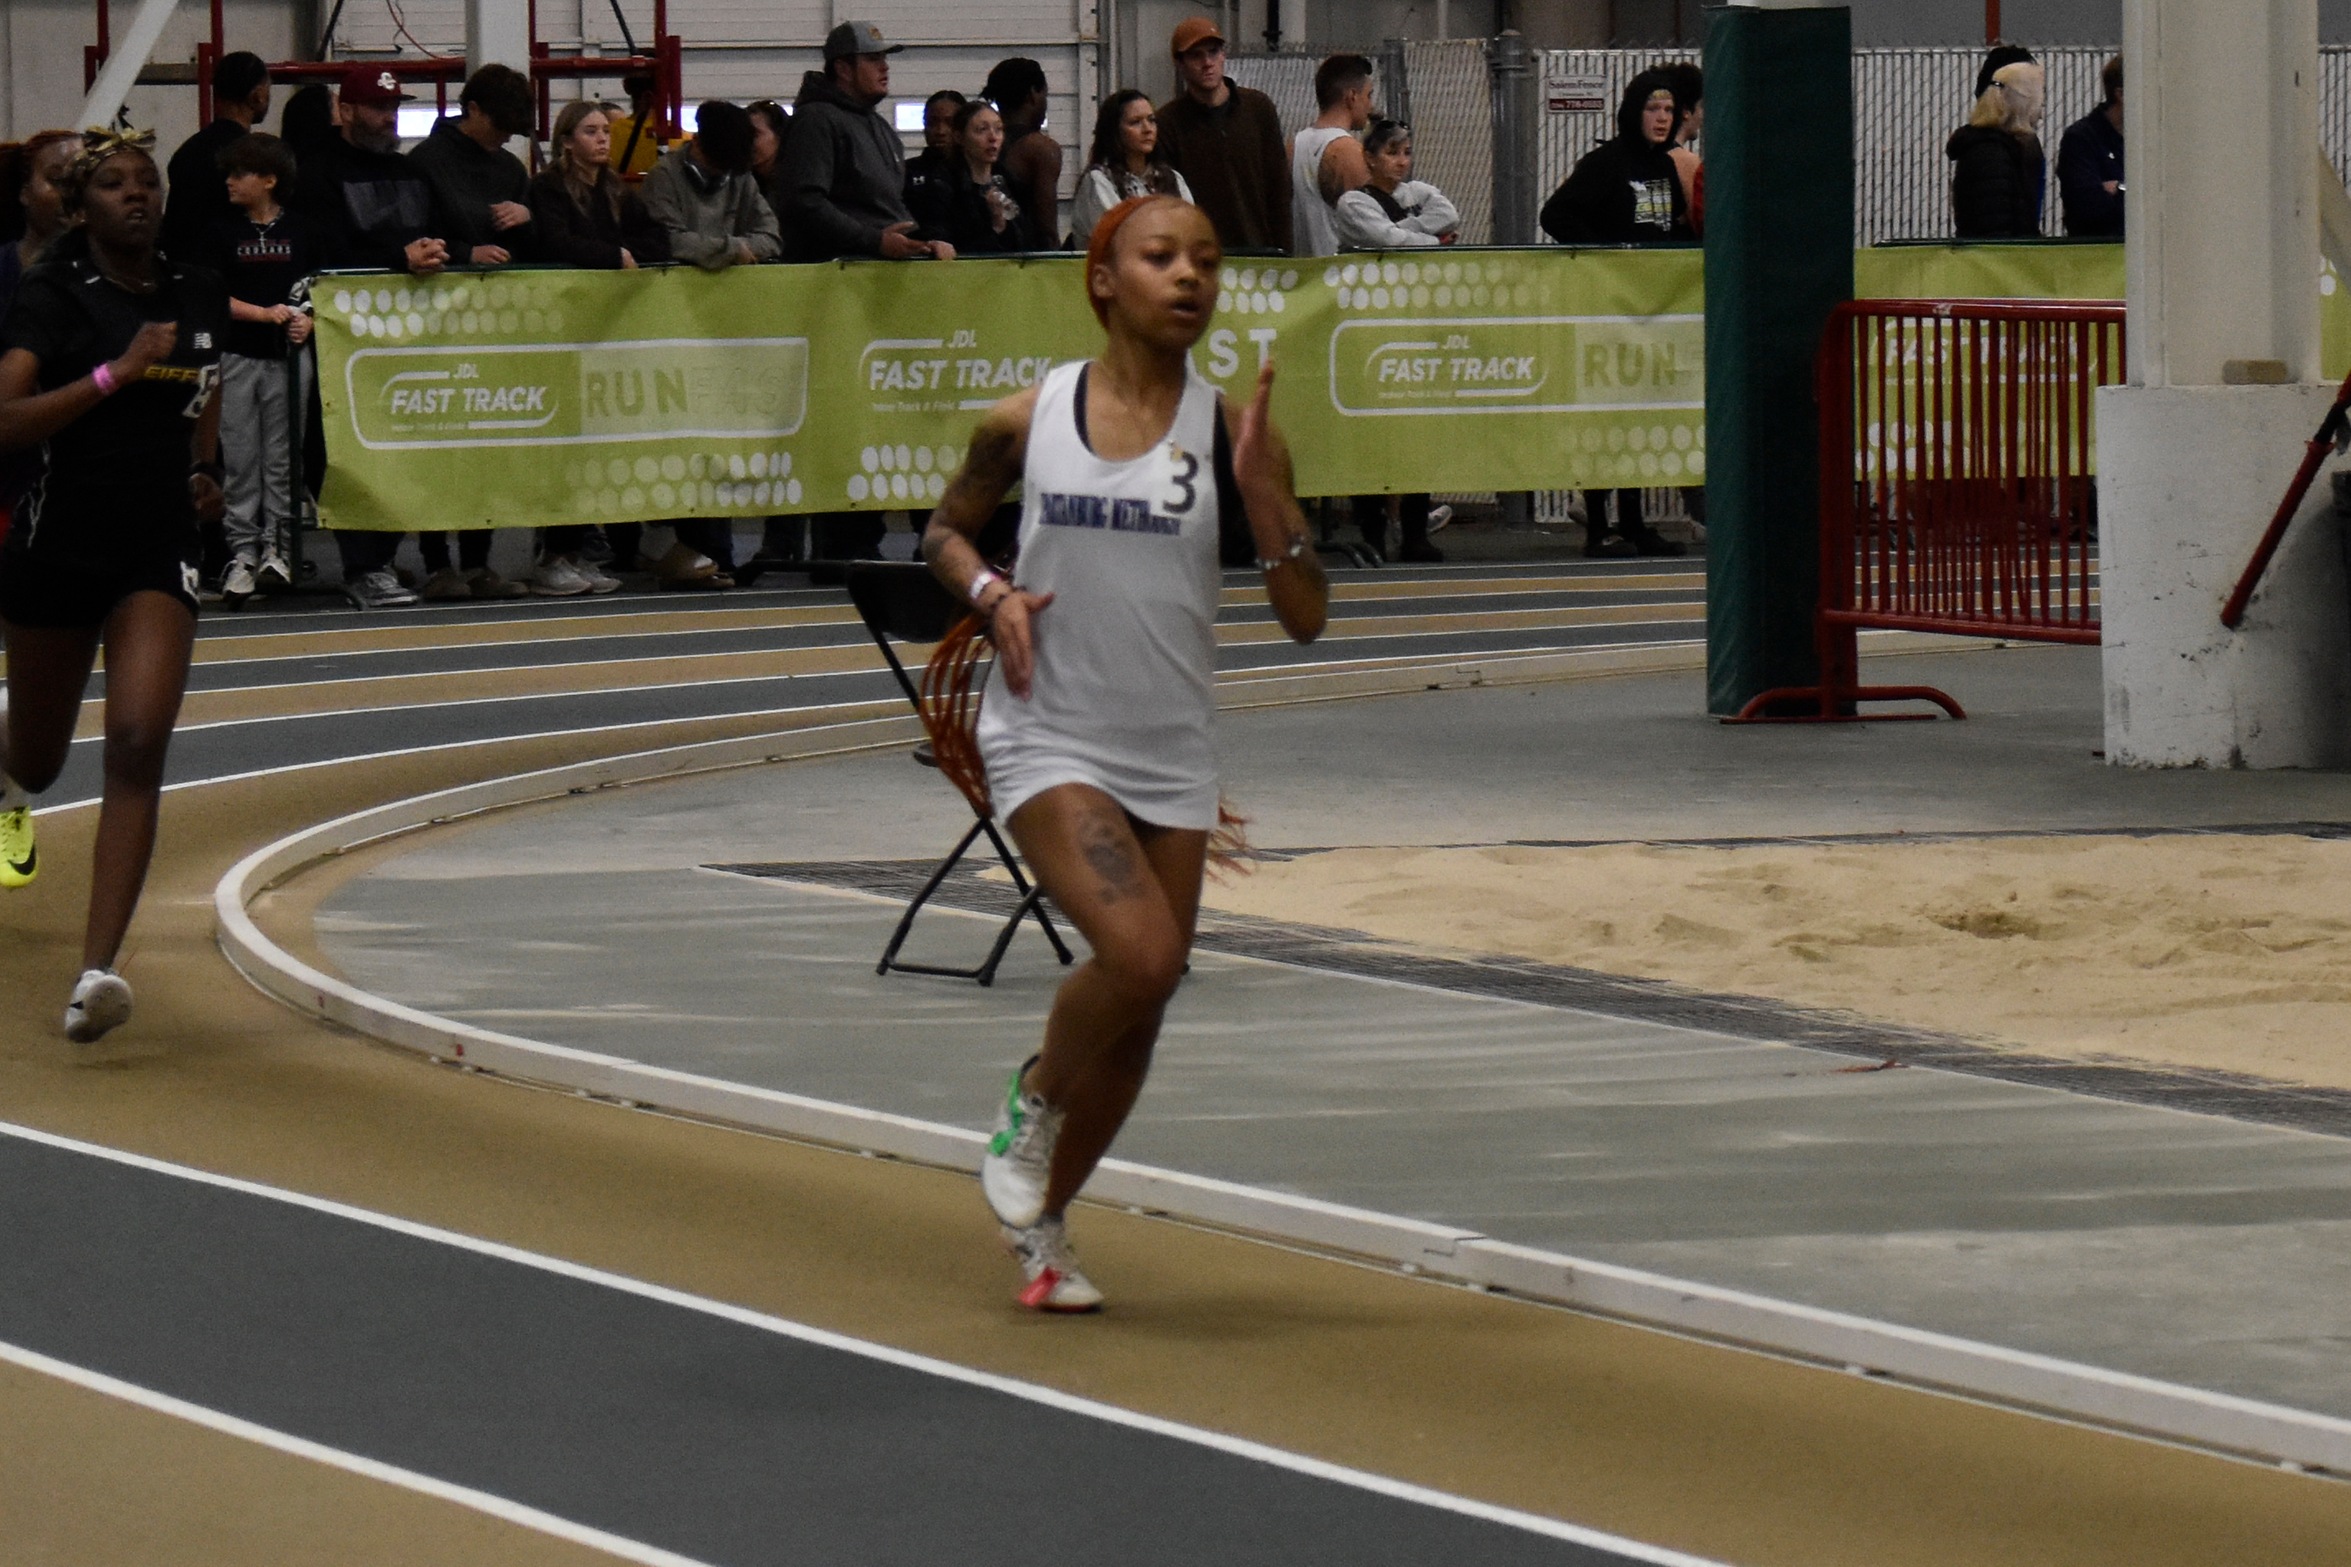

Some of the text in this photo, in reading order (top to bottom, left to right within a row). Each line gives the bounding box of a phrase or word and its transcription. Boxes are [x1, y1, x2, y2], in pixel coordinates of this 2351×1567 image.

[949, 330, 977, 348] JDL
[1208, 328, 1277, 377] ST
[1442, 335, 1470, 349] JDL
[454, 363, 479, 379] JDL
[870, 356, 1051, 391] FAST TRACK
[1378, 356, 1535, 382] FAST TRACK
[1583, 342, 1676, 387] RUN
[391, 386, 547, 414] FAST TRACK
[586, 366, 688, 417] RUN
[1163, 450, 1199, 514] 3
